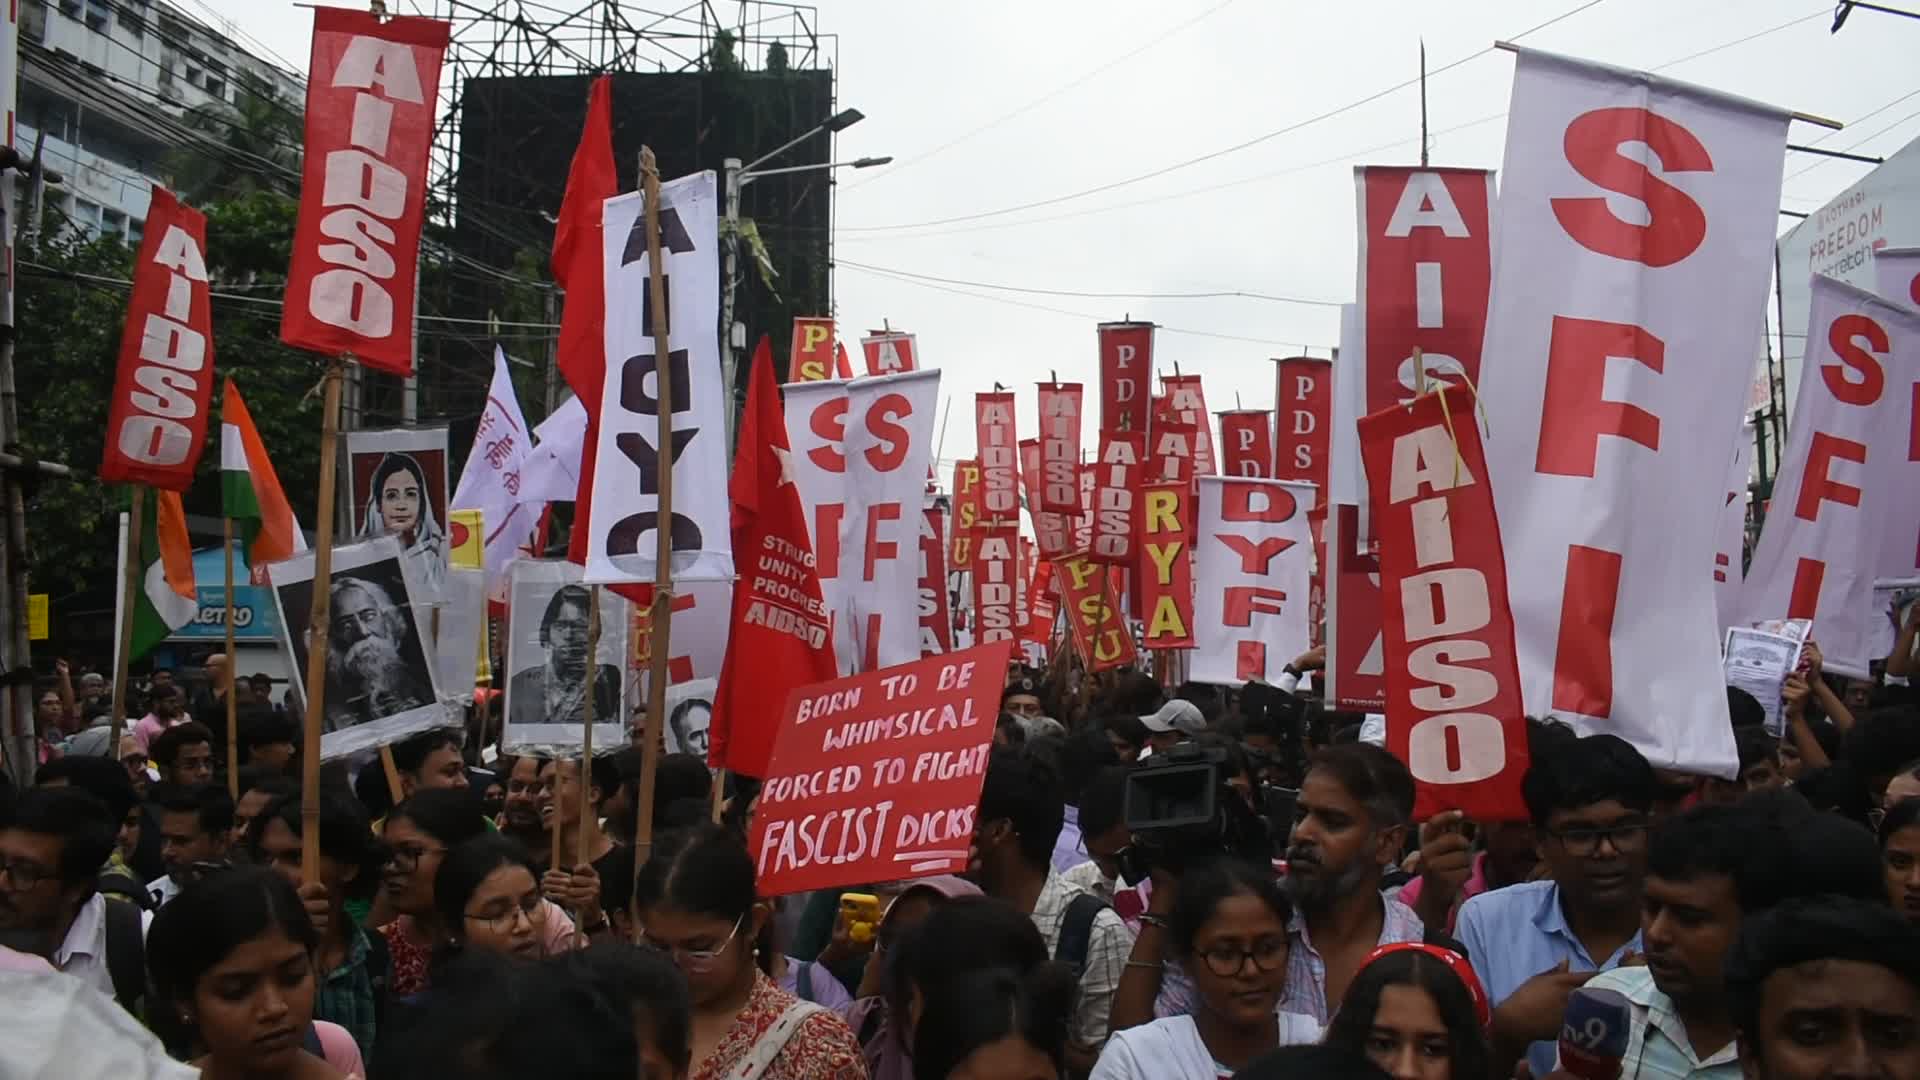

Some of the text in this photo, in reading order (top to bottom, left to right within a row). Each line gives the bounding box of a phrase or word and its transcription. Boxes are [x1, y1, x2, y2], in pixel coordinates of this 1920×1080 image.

[308, 36, 424, 339] AIDSO
[1809, 203, 1882, 265] FREEDOM
[1384, 172, 1471, 403] AIS
[118, 223, 209, 466] AIDSO
[982, 403, 1014, 511] AIDSO
[1047, 394, 1077, 505] AIDSO
[1295, 375, 1317, 470] PDS
[1535, 106, 1715, 719] SFI
[954, 467, 979, 565] PSU
[1096, 440, 1136, 556] AIDSO
[1788, 314, 1892, 640] SFI
[758, 555, 808, 586] UNITY
[863, 393, 913, 672] SFI
[1144, 490, 1187, 639] RYA
[1214, 482, 1298, 681] DYFI
[743, 602, 827, 650] AIDSO
[1066, 560, 1122, 661] PSU
[1389, 424, 1507, 784] AIDSO
[795, 661, 976, 725] BORN TO BE
[822, 697, 978, 752] WHIMSICAL
[762, 743, 990, 804] FORCED TO FIGHT
[757, 801, 977, 877] FASCIST DICKS
